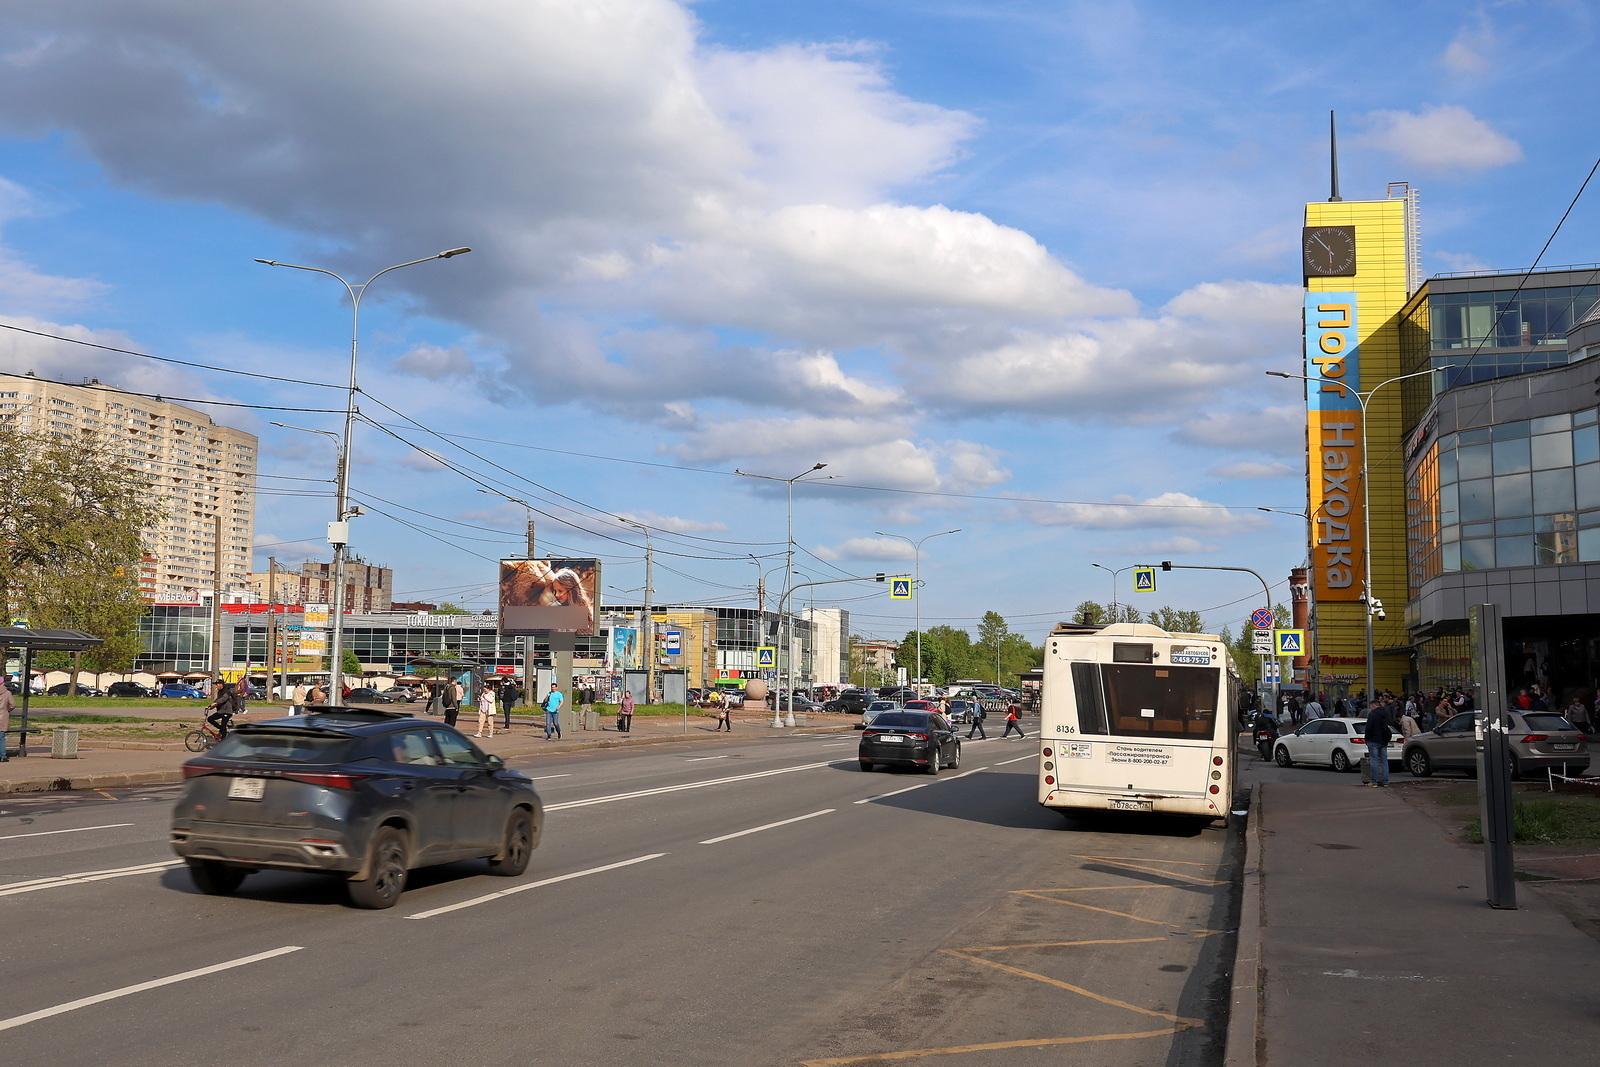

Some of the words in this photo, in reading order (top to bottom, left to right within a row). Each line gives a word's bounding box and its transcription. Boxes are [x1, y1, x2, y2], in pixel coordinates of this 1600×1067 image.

[1317, 422, 1355, 588] Находка
[158, 593, 192, 601] МЕБЕЛЬ
[1056, 725, 1075, 734] 8136
